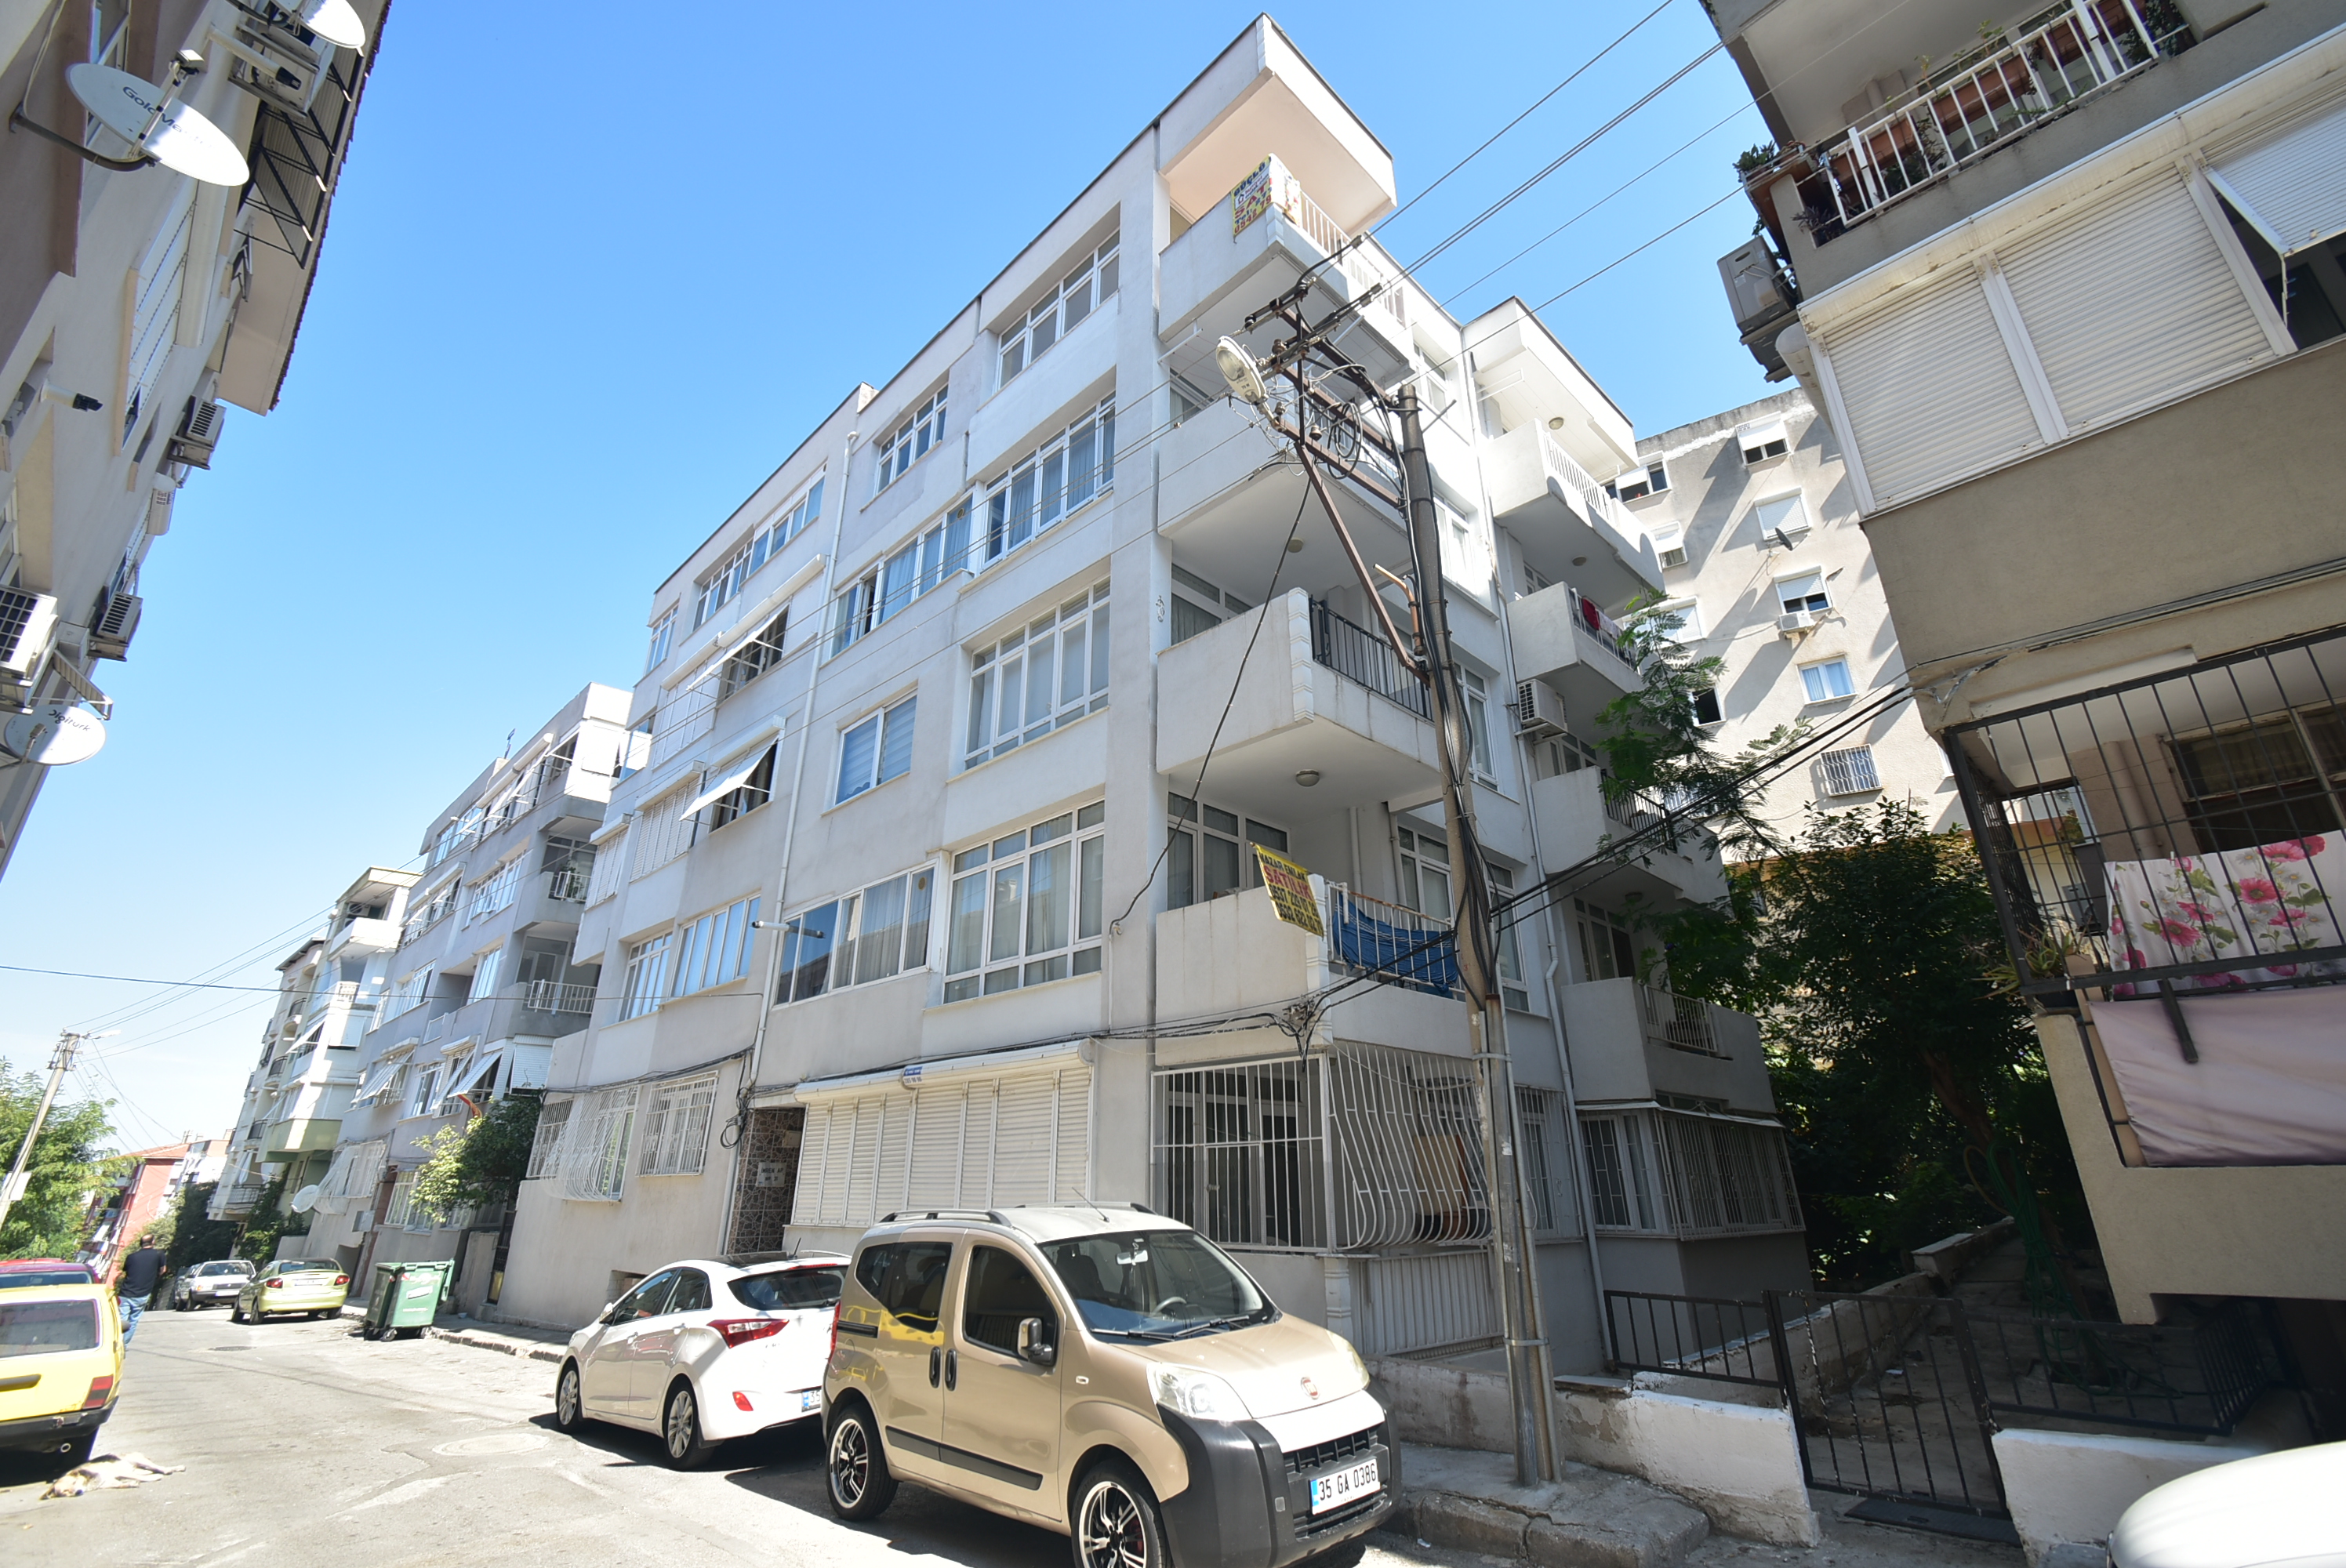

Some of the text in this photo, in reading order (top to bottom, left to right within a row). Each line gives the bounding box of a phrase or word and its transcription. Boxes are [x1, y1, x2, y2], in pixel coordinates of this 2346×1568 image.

[1263, 865, 1314, 902] SATILIK
[1284, 864, 1307, 883] EMLAK
[1319, 1463, 1376, 1501] 35 GA 0386
